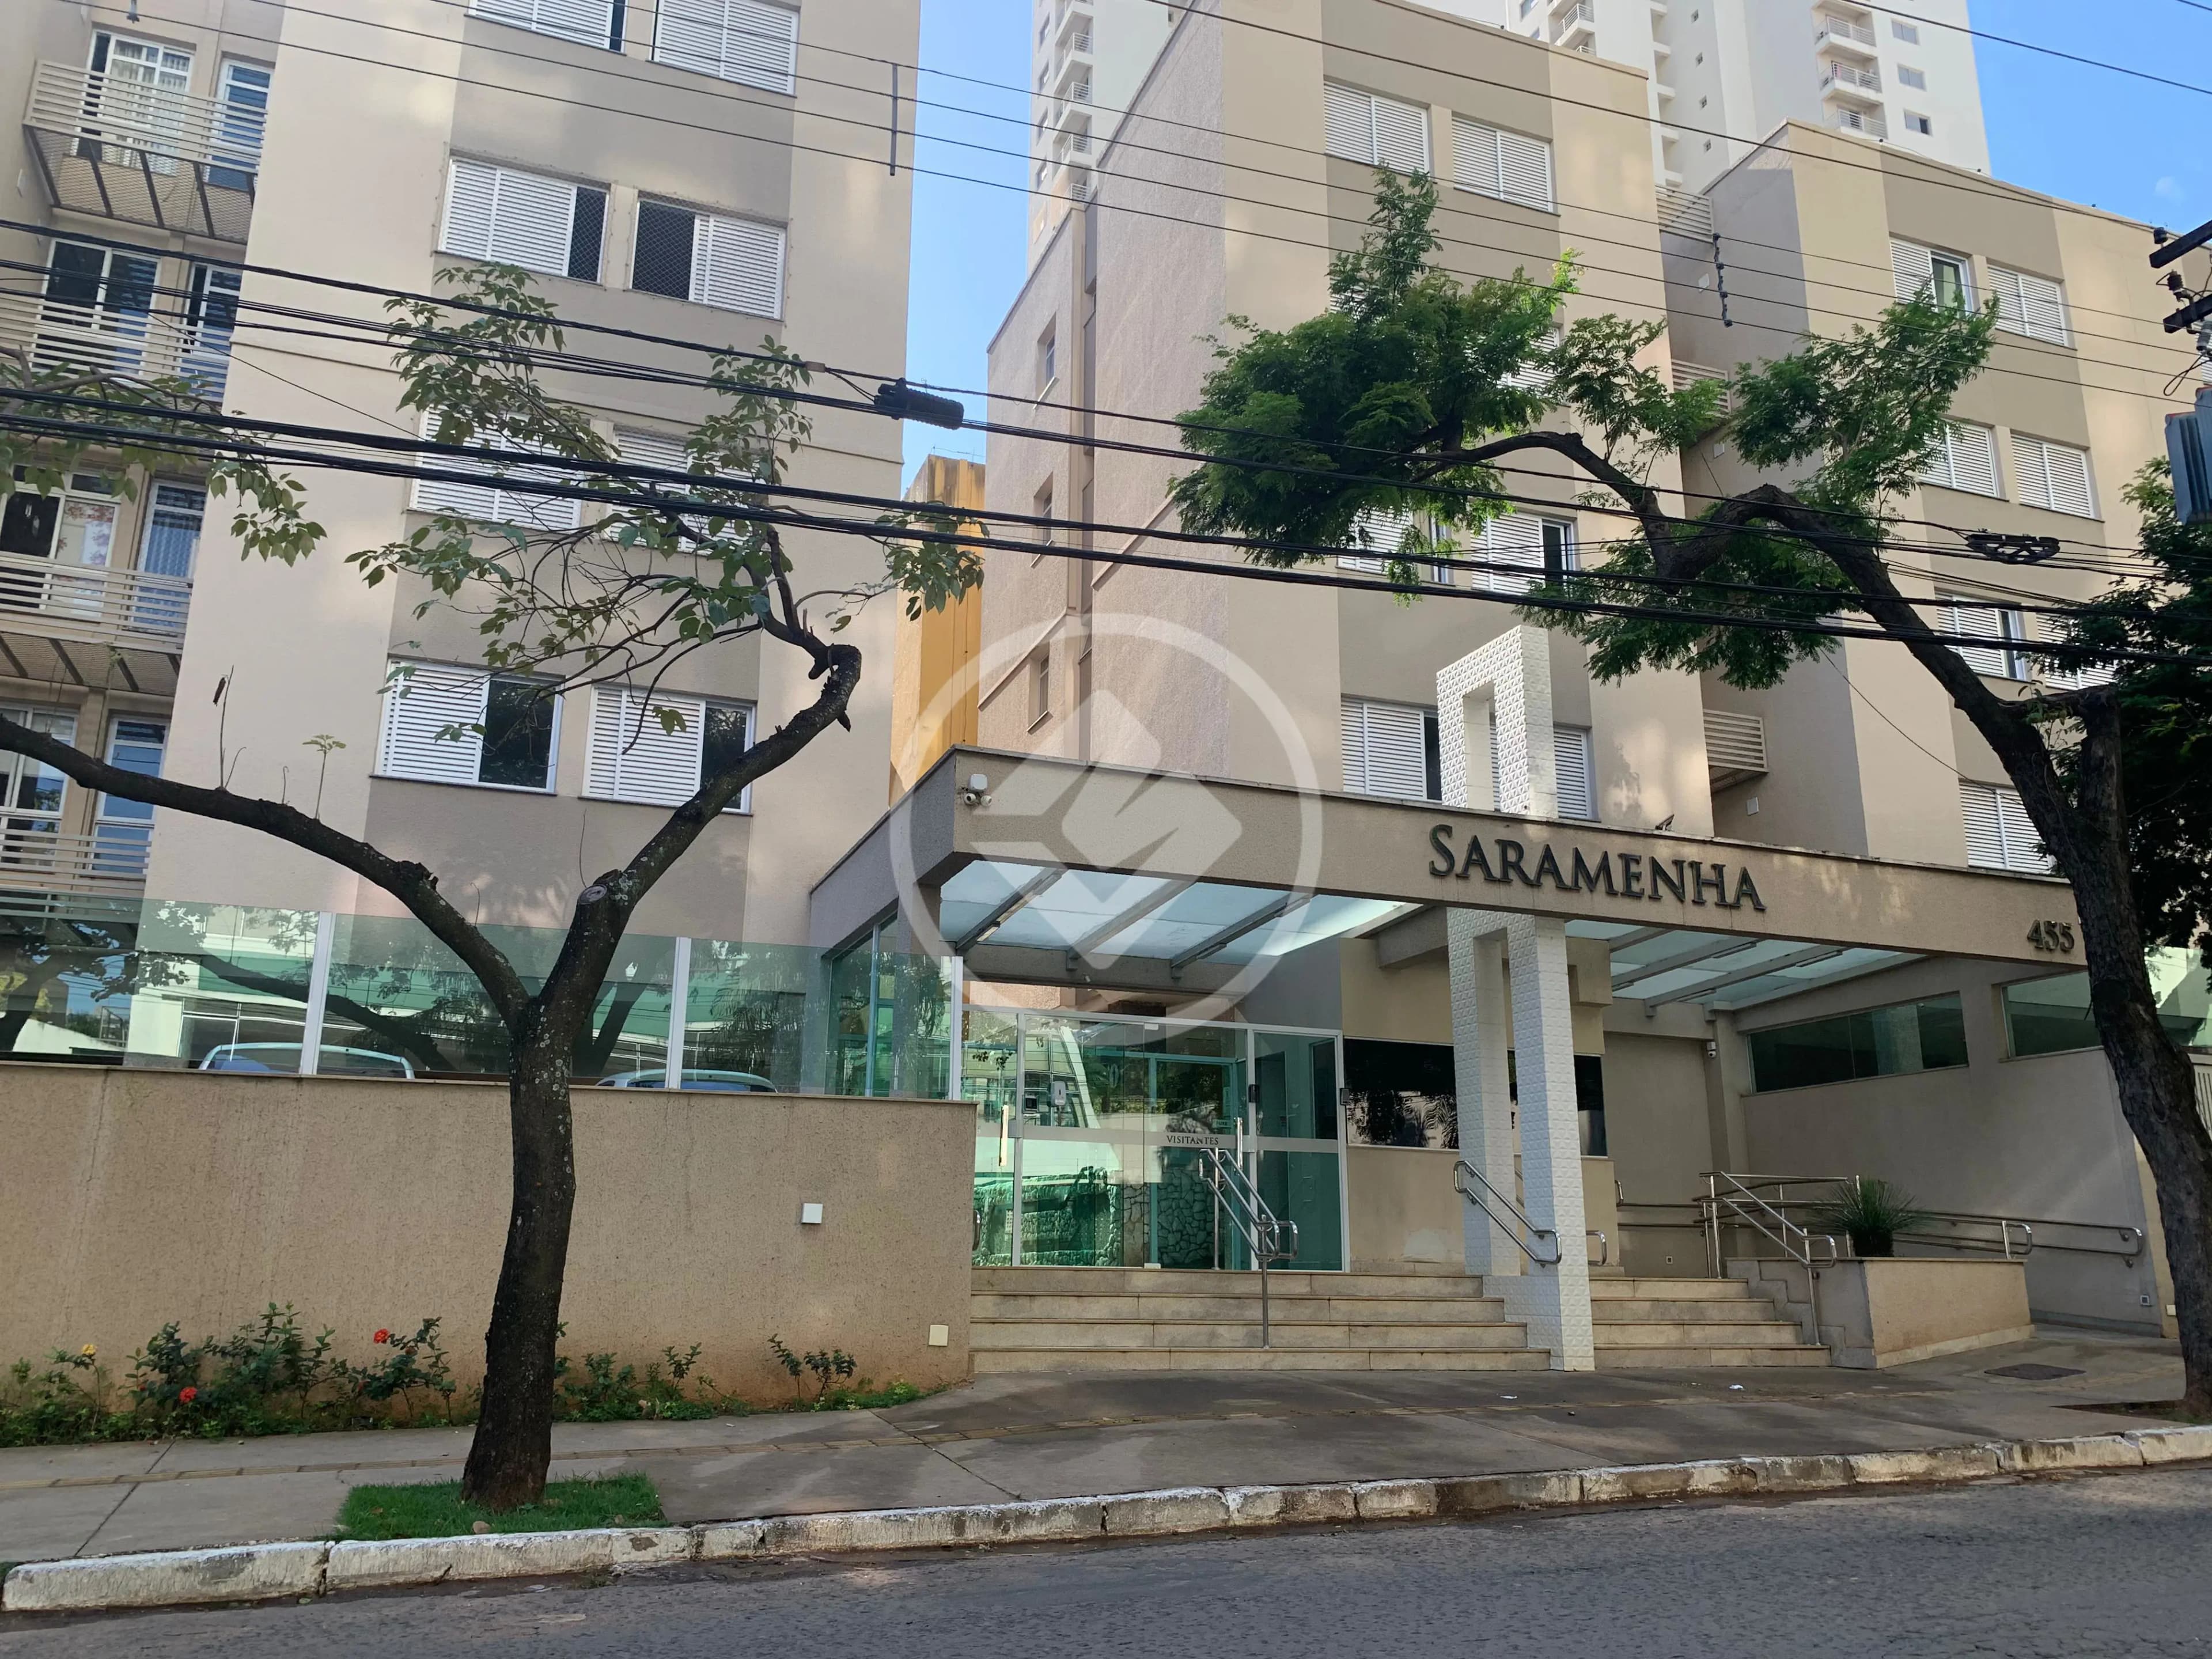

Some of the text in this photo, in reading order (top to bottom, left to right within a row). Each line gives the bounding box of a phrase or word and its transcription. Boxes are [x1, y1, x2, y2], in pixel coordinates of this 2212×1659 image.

[1429, 824, 1766, 910] SARAMENHA
[2027, 919, 2074, 951] 455
[1166, 1135, 1219, 1145] VISITANTES
